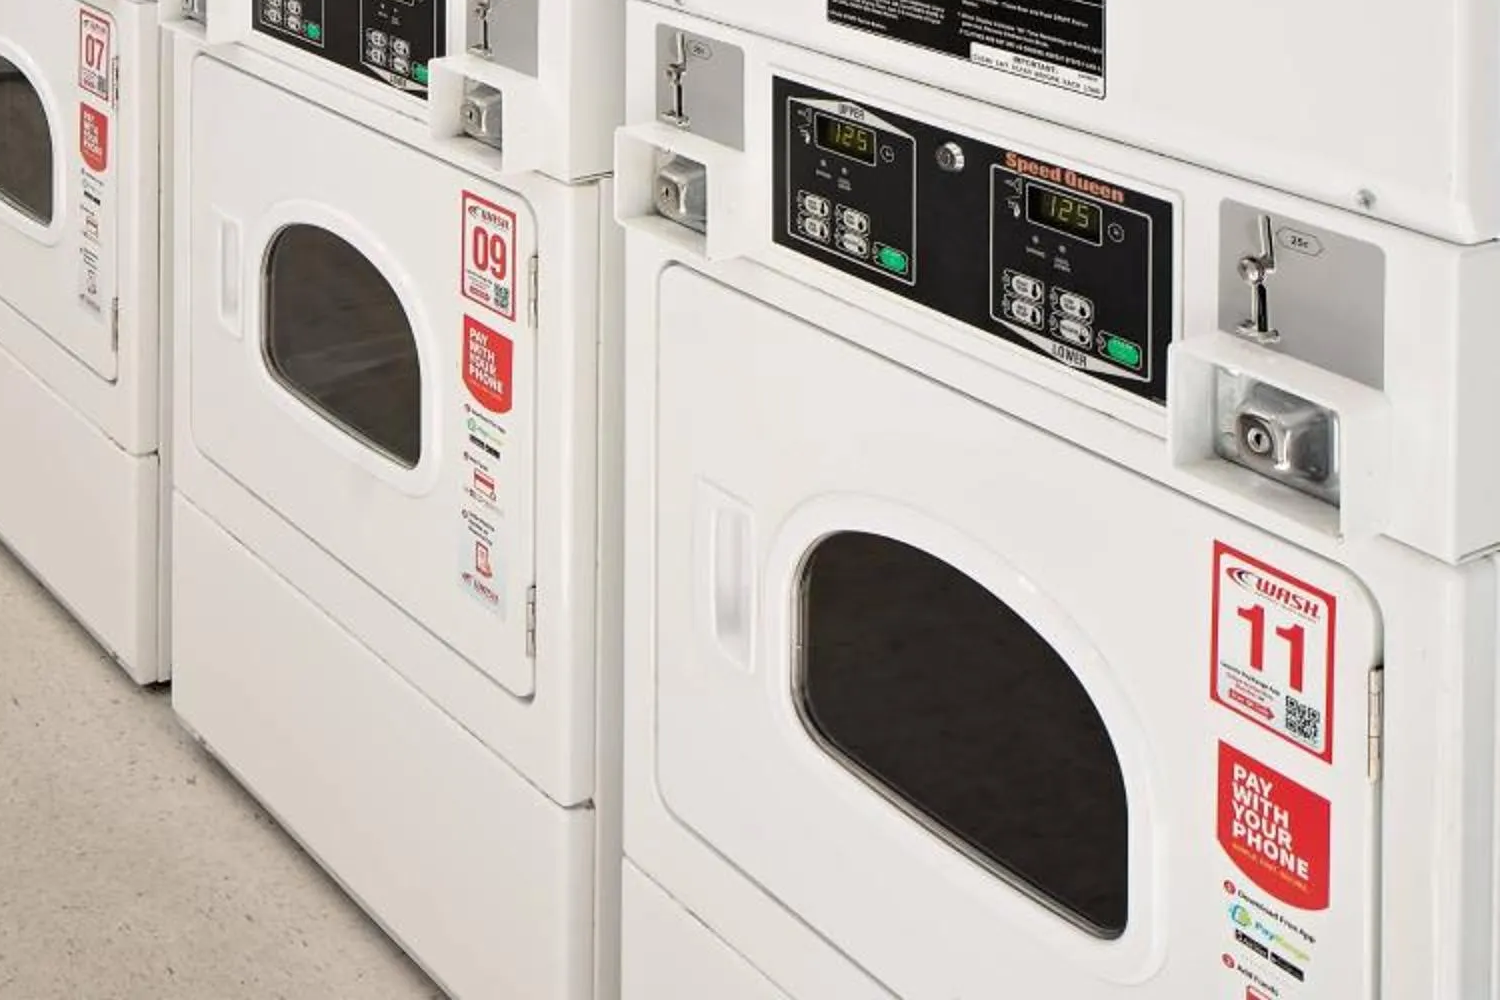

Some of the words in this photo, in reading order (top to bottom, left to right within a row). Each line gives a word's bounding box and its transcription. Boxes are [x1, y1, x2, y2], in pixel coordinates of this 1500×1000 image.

[86, 33, 104, 70] 07
[835, 123, 867, 151] 125
[1005, 151, 1063, 183] Speed
[1065, 168, 1125, 203] Queen
[1050, 195, 1090, 228] 125
[473, 225, 506, 280] 09
[1052, 343, 1088, 368] LOWER
[1256, 577, 1320, 617] WASH
[1237, 604, 1304, 692] 11
[1233, 763, 1273, 798] PAY
[1232, 781, 1289, 828] WITH
[1232, 800, 1292, 850] YOUR
[1232, 819, 1309, 880] PHONE
